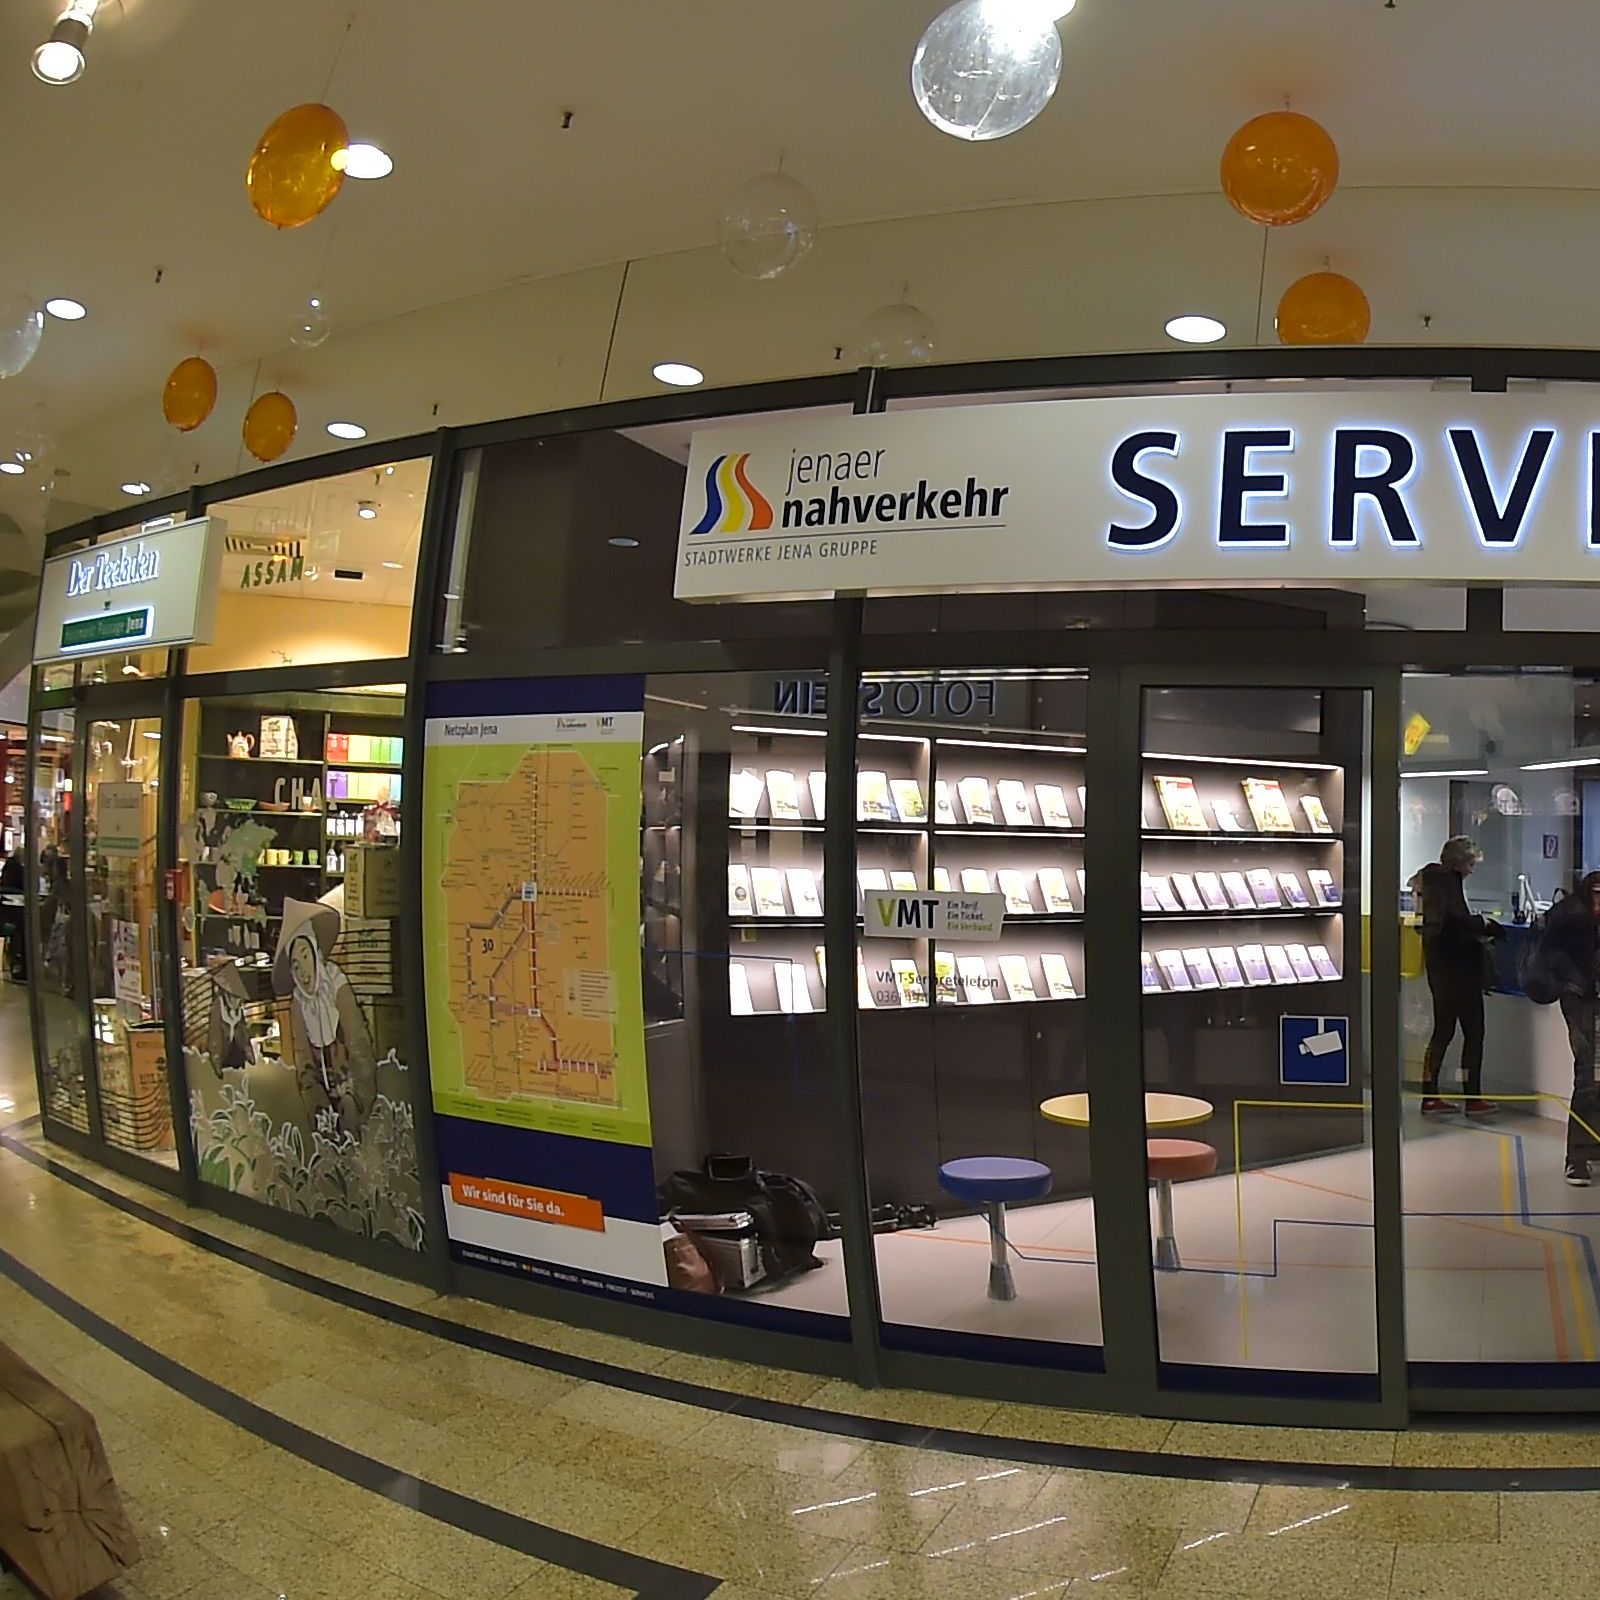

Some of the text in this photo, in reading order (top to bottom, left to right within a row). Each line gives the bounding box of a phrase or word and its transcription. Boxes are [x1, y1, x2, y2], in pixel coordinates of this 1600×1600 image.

[785, 448, 886, 497] jenaer
[782, 477, 1010, 529] nahverkehr
[684, 540, 878, 567] STADTWERKE JENA GRUPPE
[66, 560, 95, 597] Der
[240, 555, 304, 589] ASSAM
[444, 723, 498, 739] Netzplan Jena
[274, 777, 337, 811] CHAI
[877, 898, 939, 929] VMT
[947, 901, 979, 911] Ein Tarif.
[947, 911, 983, 921] Ein Ticket.
[947, 922, 959, 930] Ein
[481, 938, 494, 954] 30
[461, 1184, 565, 1217] Wir sind für Sie da.
